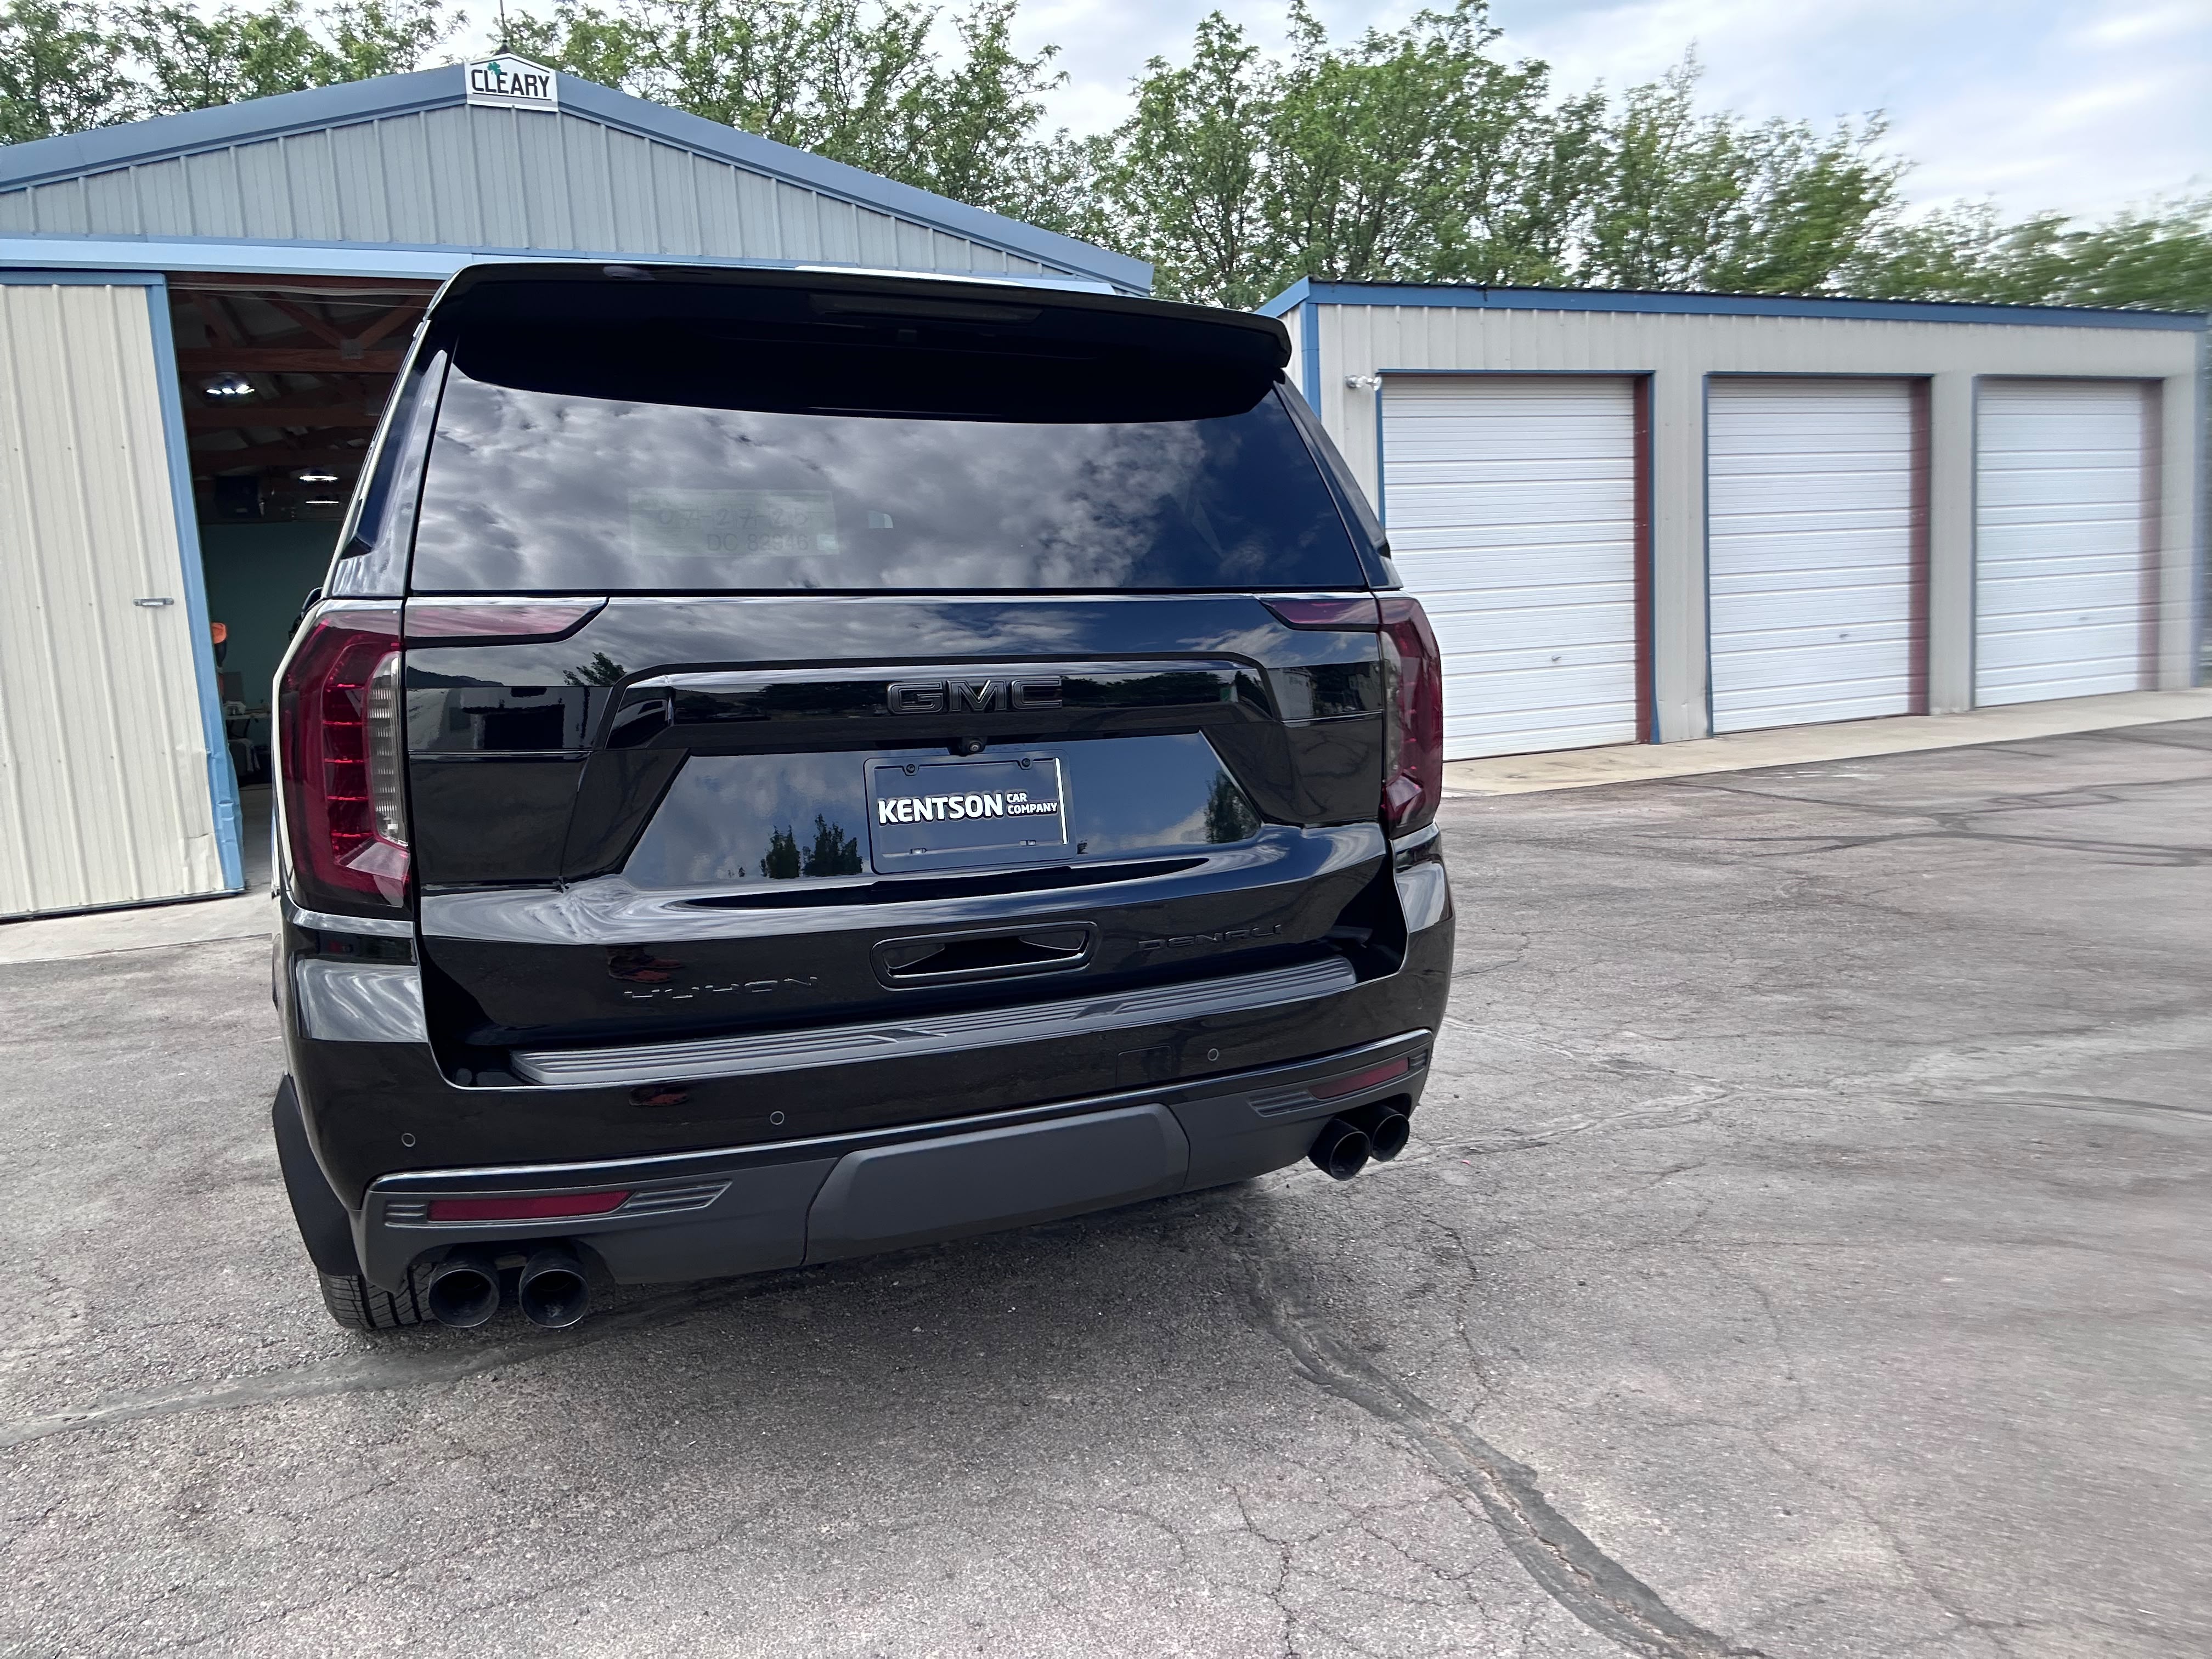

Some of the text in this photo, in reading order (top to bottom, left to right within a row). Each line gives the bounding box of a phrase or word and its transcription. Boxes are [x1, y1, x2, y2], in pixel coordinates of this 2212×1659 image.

[471, 69, 550, 97] CLEARY
[707, 533, 738, 552] DC
[887, 677, 1063, 714] GMC
[878, 793, 1004, 824] KENTSON
[1006, 793, 1028, 803] CAR
[1007, 802, 1058, 815] COMPANY
